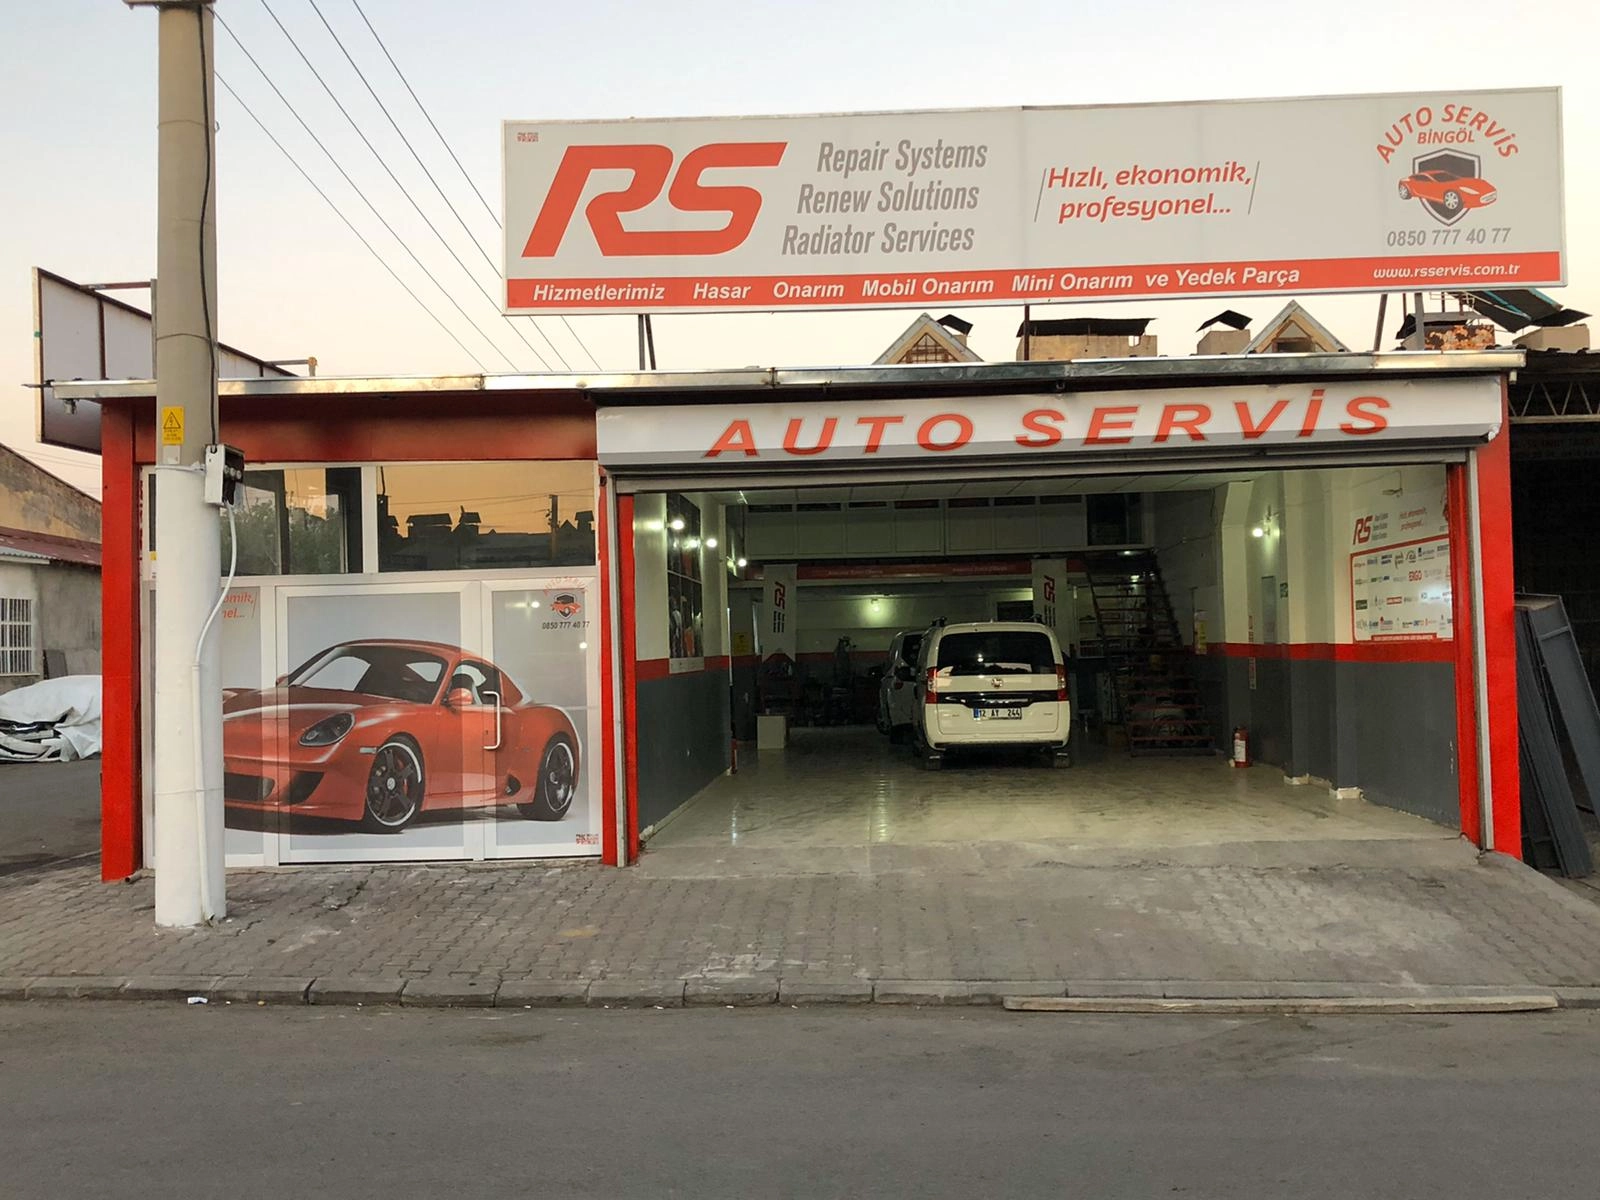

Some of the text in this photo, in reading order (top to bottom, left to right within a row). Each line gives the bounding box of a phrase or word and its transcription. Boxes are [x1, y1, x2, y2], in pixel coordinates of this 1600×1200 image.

[1376, 104, 1519, 164] AUTO SERVİS
[1417, 127, 1475, 144] BİNGÖL
[816, 138, 988, 179] Repair Systems
[1048, 161, 1253, 190] Hızlı, ekonomik,
[520, 141, 788, 258] RS
[796, 180, 979, 214] Renew Solutions
[1058, 193, 1232, 224] profesyonel...
[781, 221, 975, 256] Radiator Services
[1386, 227, 1512, 247] 0850 777 40 77
[532, 266, 1301, 301] Hizmetlerimiz Hasar Onarım Mobil Onarım Mini Onarım ve Yedek Parça
[1373, 264, 1521, 280] www.rsservis.com.tr
[703, 388, 1393, 458] AUTO SERVİS
